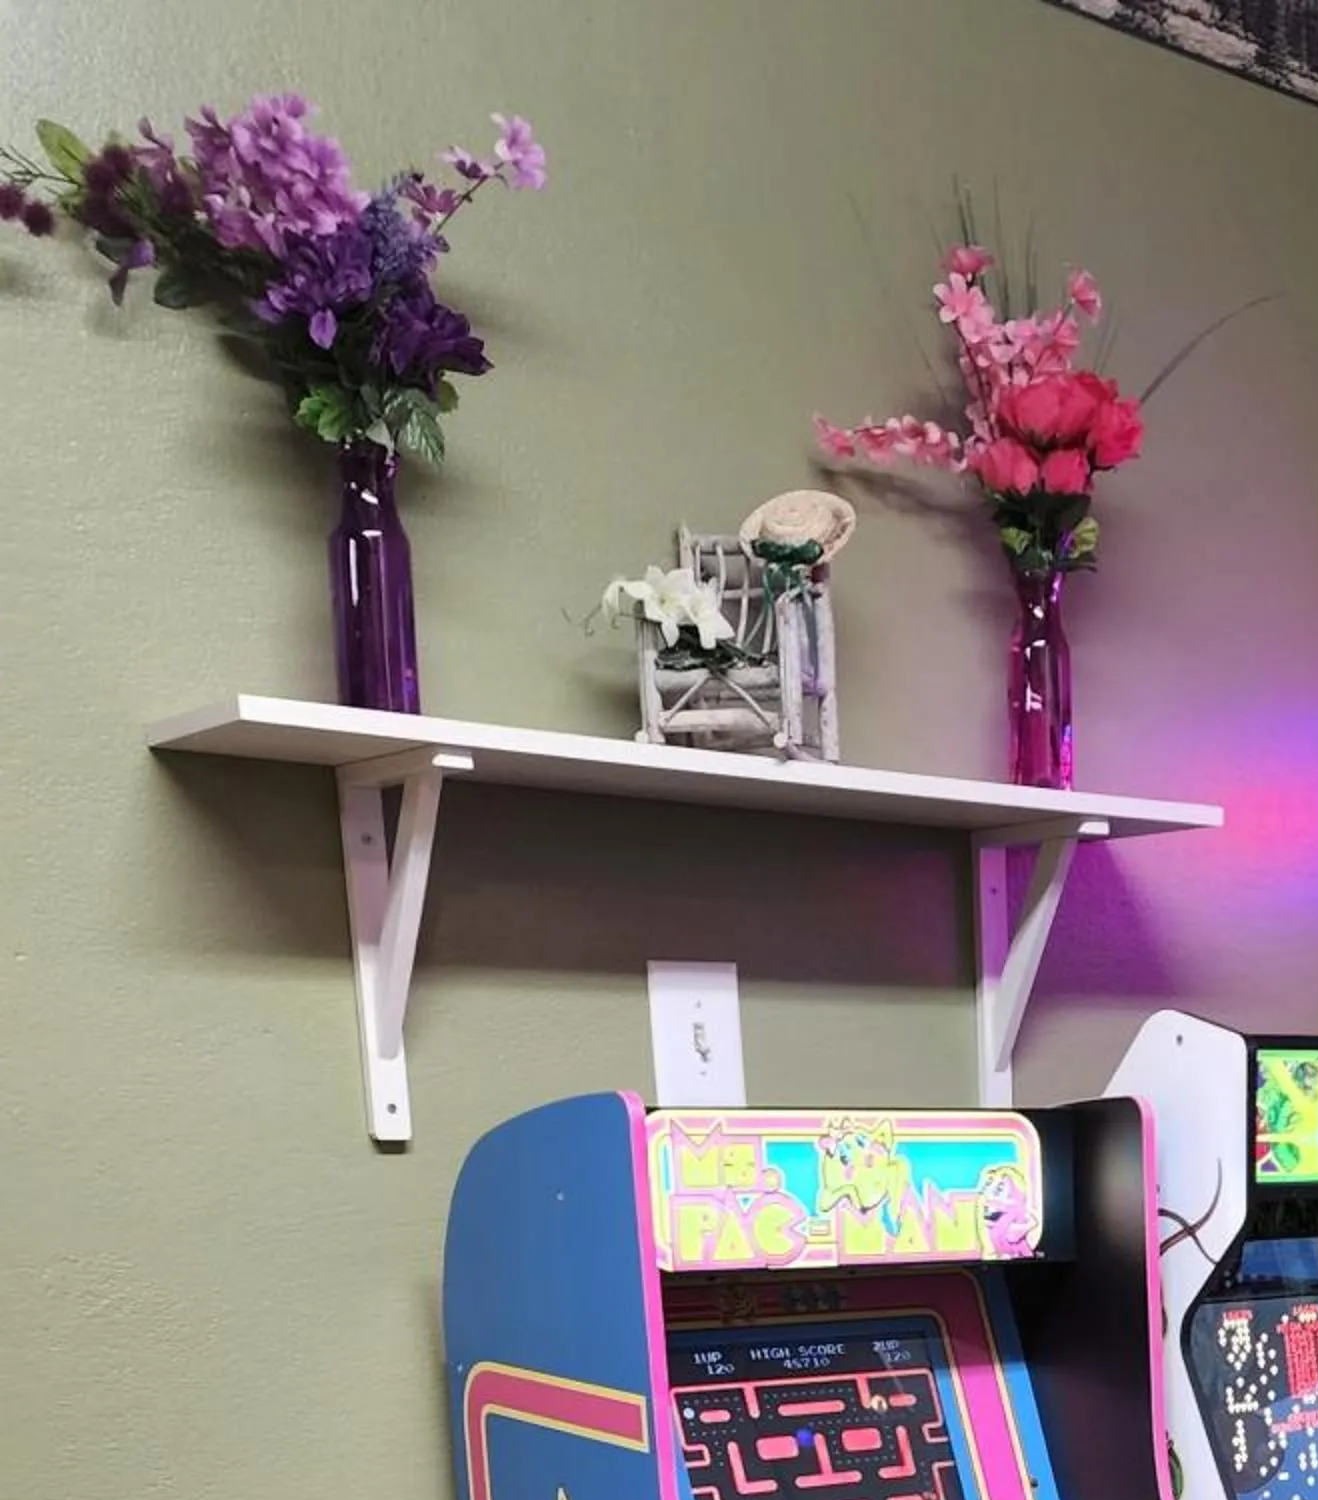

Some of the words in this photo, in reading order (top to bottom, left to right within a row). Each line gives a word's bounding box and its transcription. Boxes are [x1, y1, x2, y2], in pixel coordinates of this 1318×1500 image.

[672, 1180, 979, 1269] PAC-MAN
[692, 1351, 722, 1365] 1UP
[750, 1346, 791, 1361] HIGH
[799, 1343, 845, 1357] SCORE
[706, 1363, 736, 1375] 120
